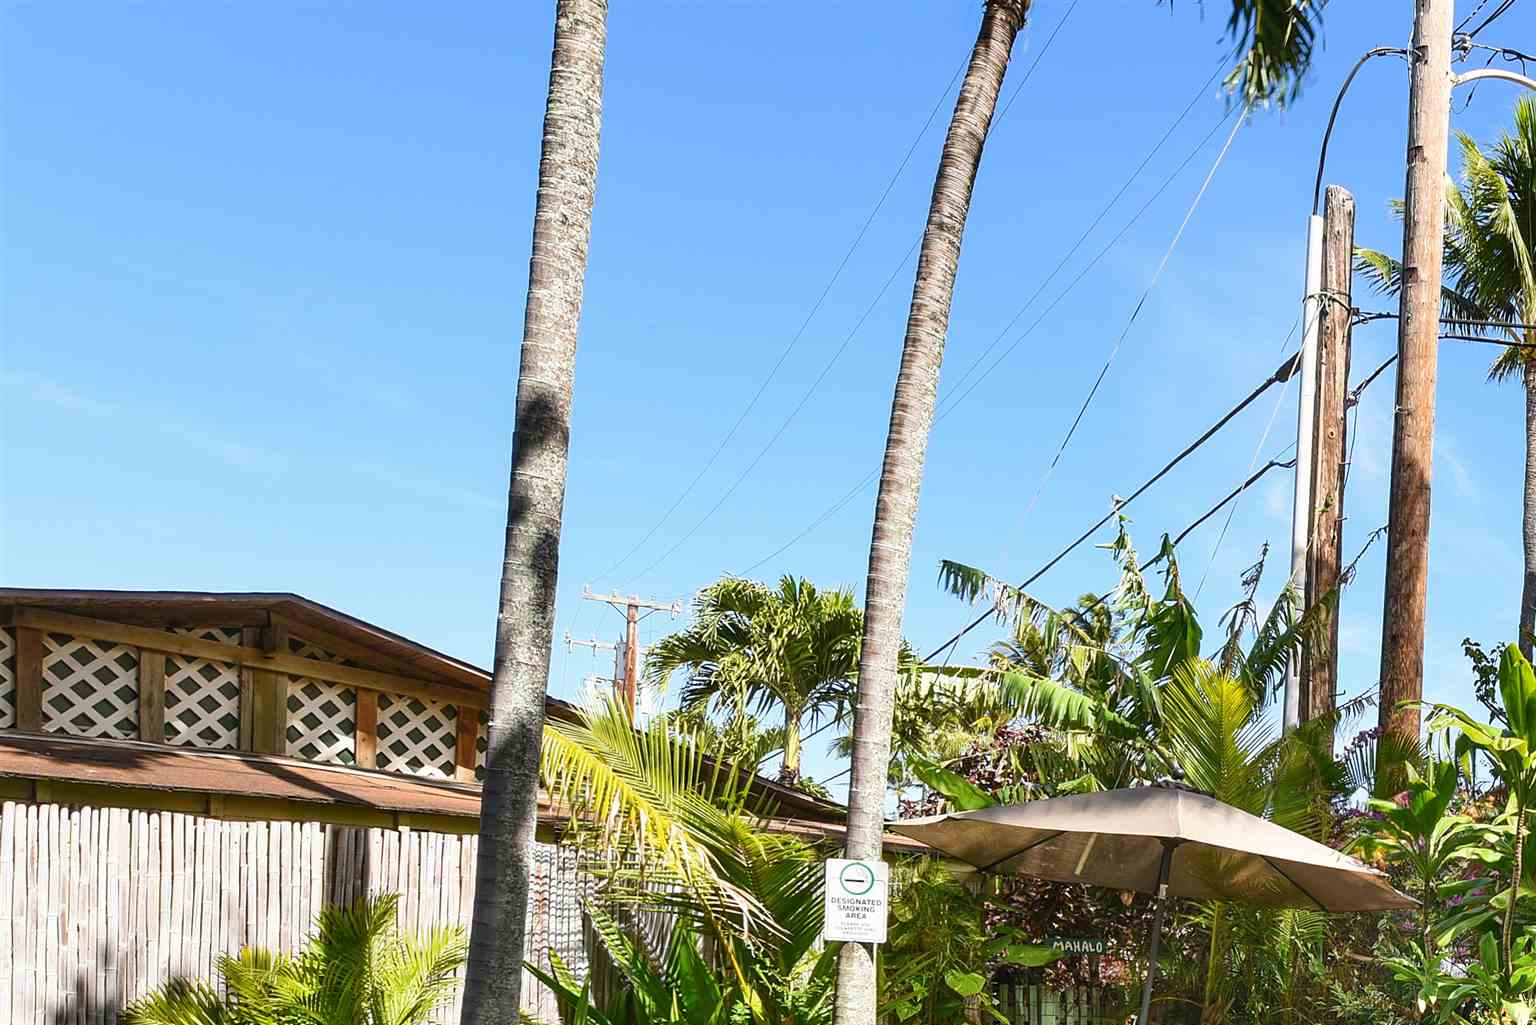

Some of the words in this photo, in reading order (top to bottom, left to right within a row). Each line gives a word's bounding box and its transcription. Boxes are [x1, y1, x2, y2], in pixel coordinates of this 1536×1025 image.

[831, 897, 882, 906] DESIGNATED
[837, 905, 875, 913] SMOKING
[1052, 940, 1103, 953] MAHALO
